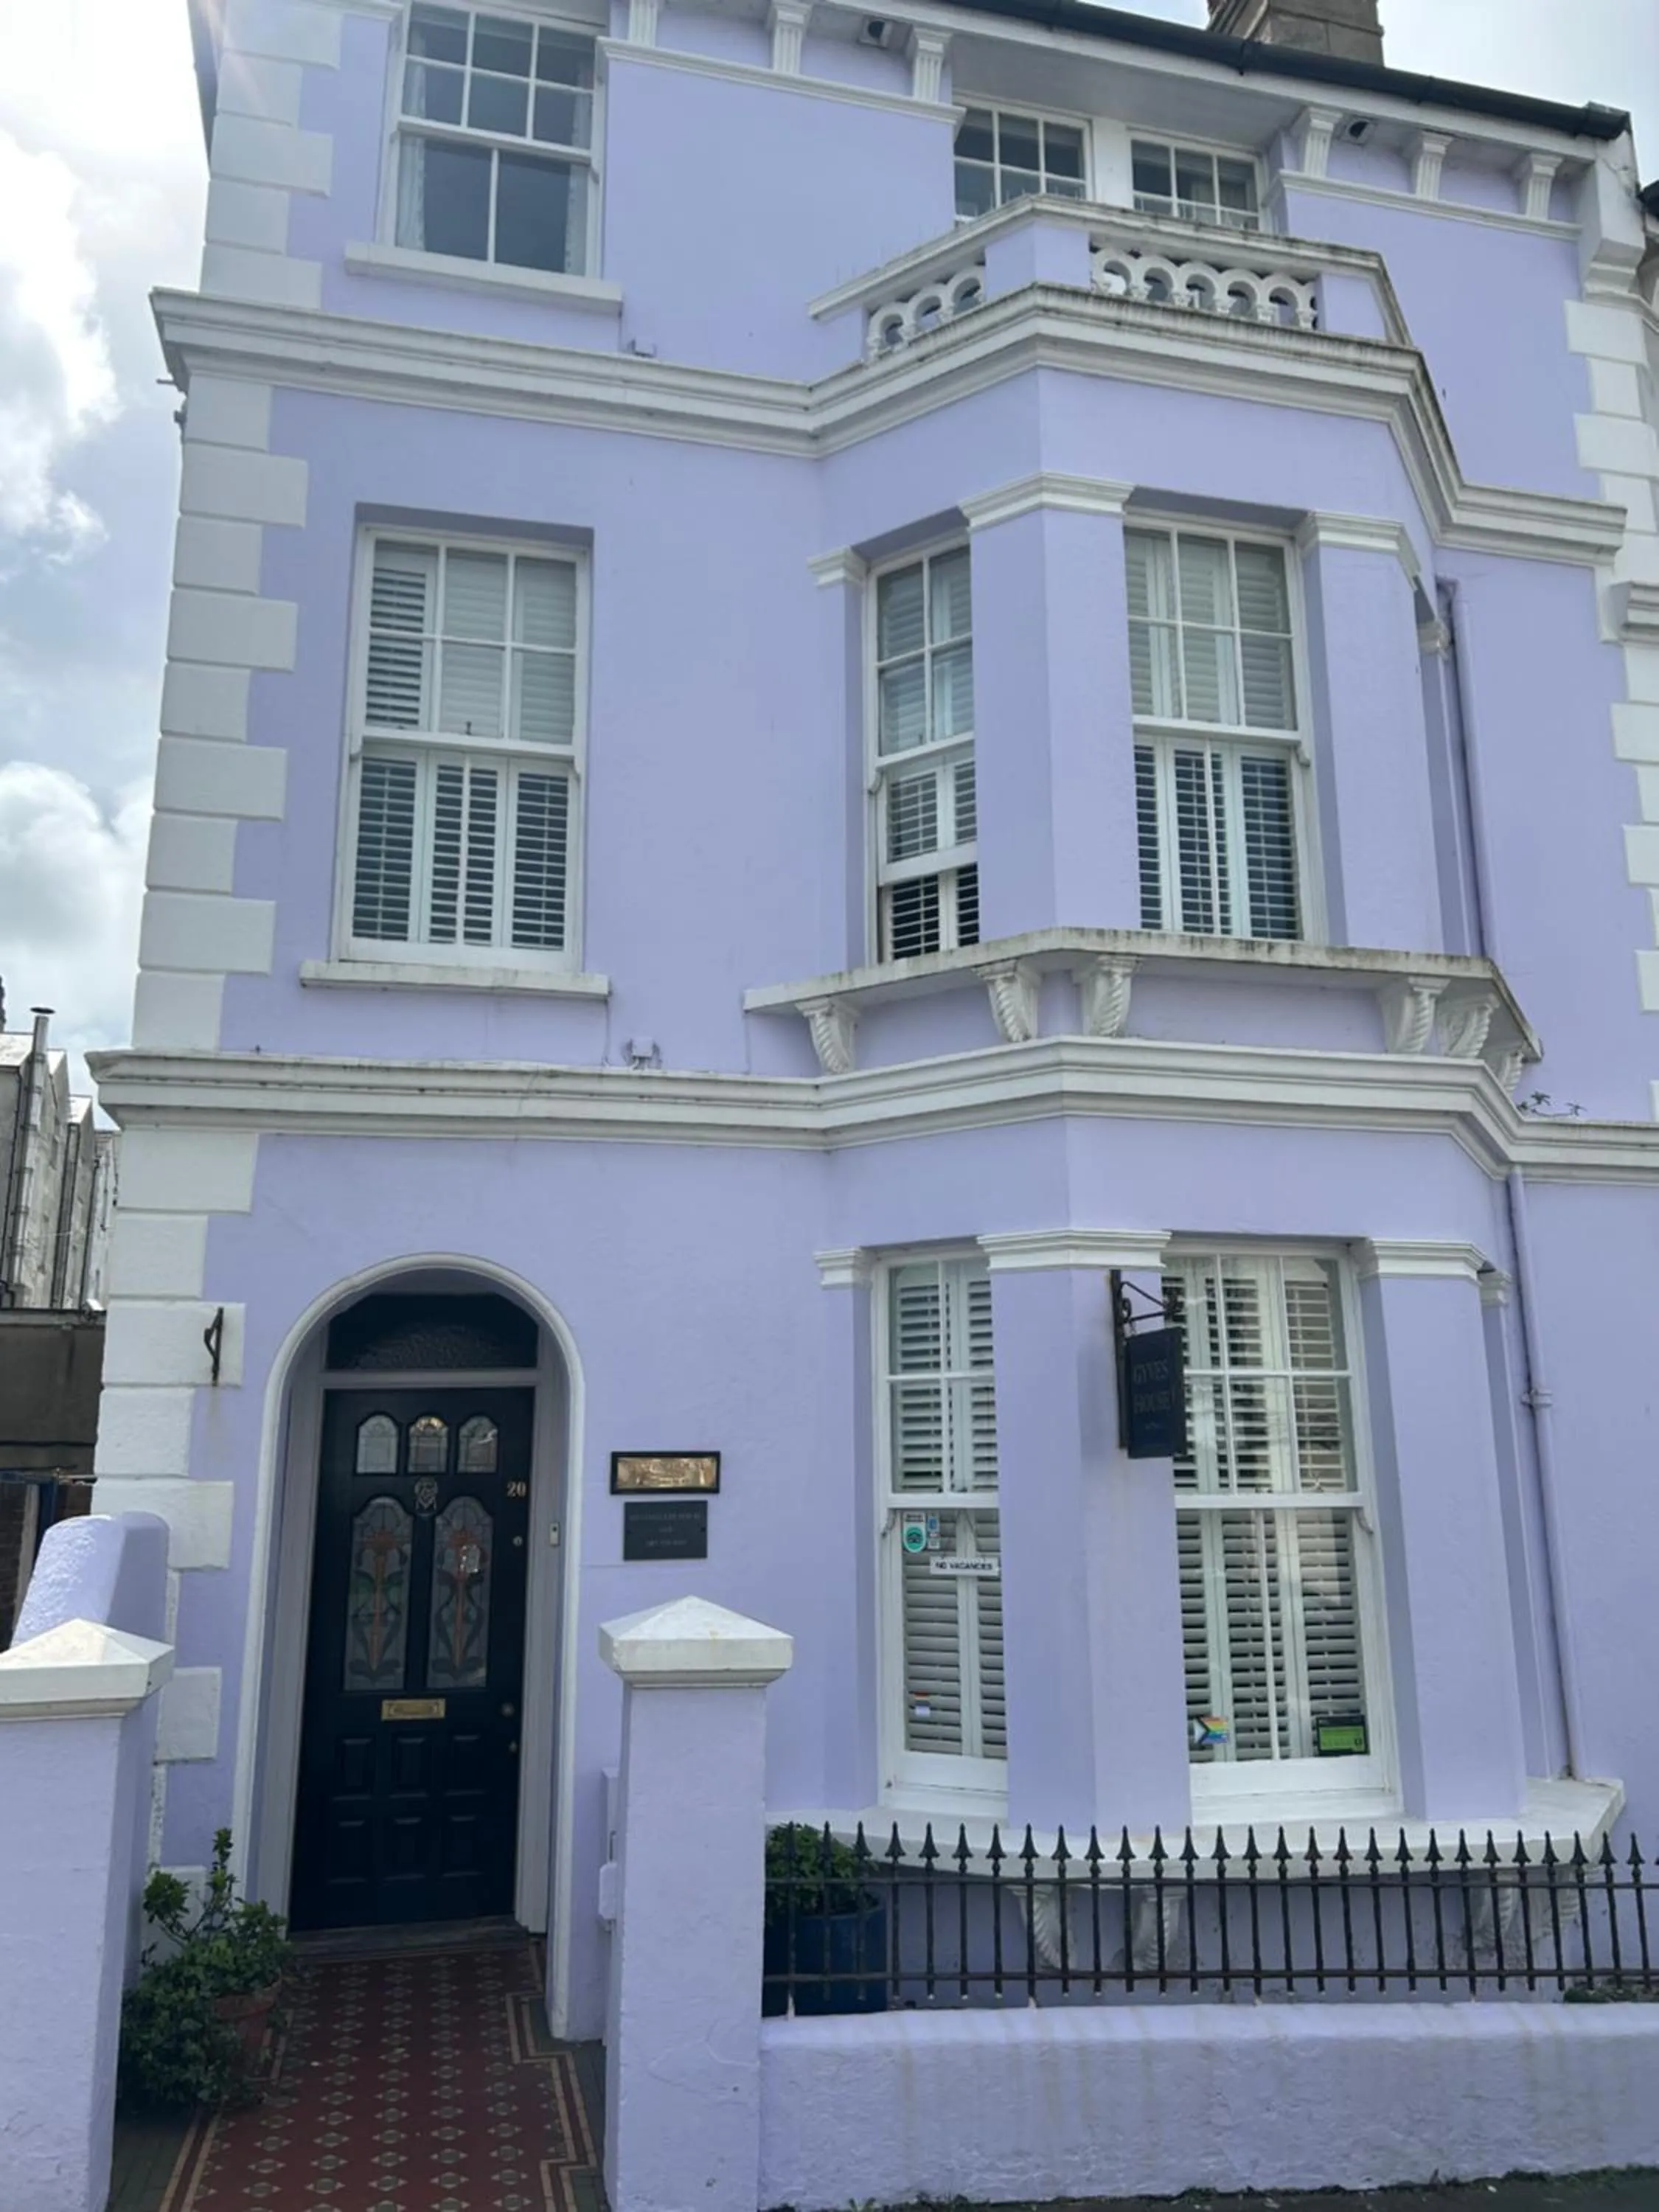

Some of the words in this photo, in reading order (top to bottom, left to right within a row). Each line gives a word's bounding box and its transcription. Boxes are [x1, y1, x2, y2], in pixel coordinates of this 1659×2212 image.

[1133, 1389, 1171, 1415] HOUSE
[507, 1481, 526, 1498] 20
[935, 1561, 947, 1570] NO
[950, 1562, 992, 1571] VACANCIES
